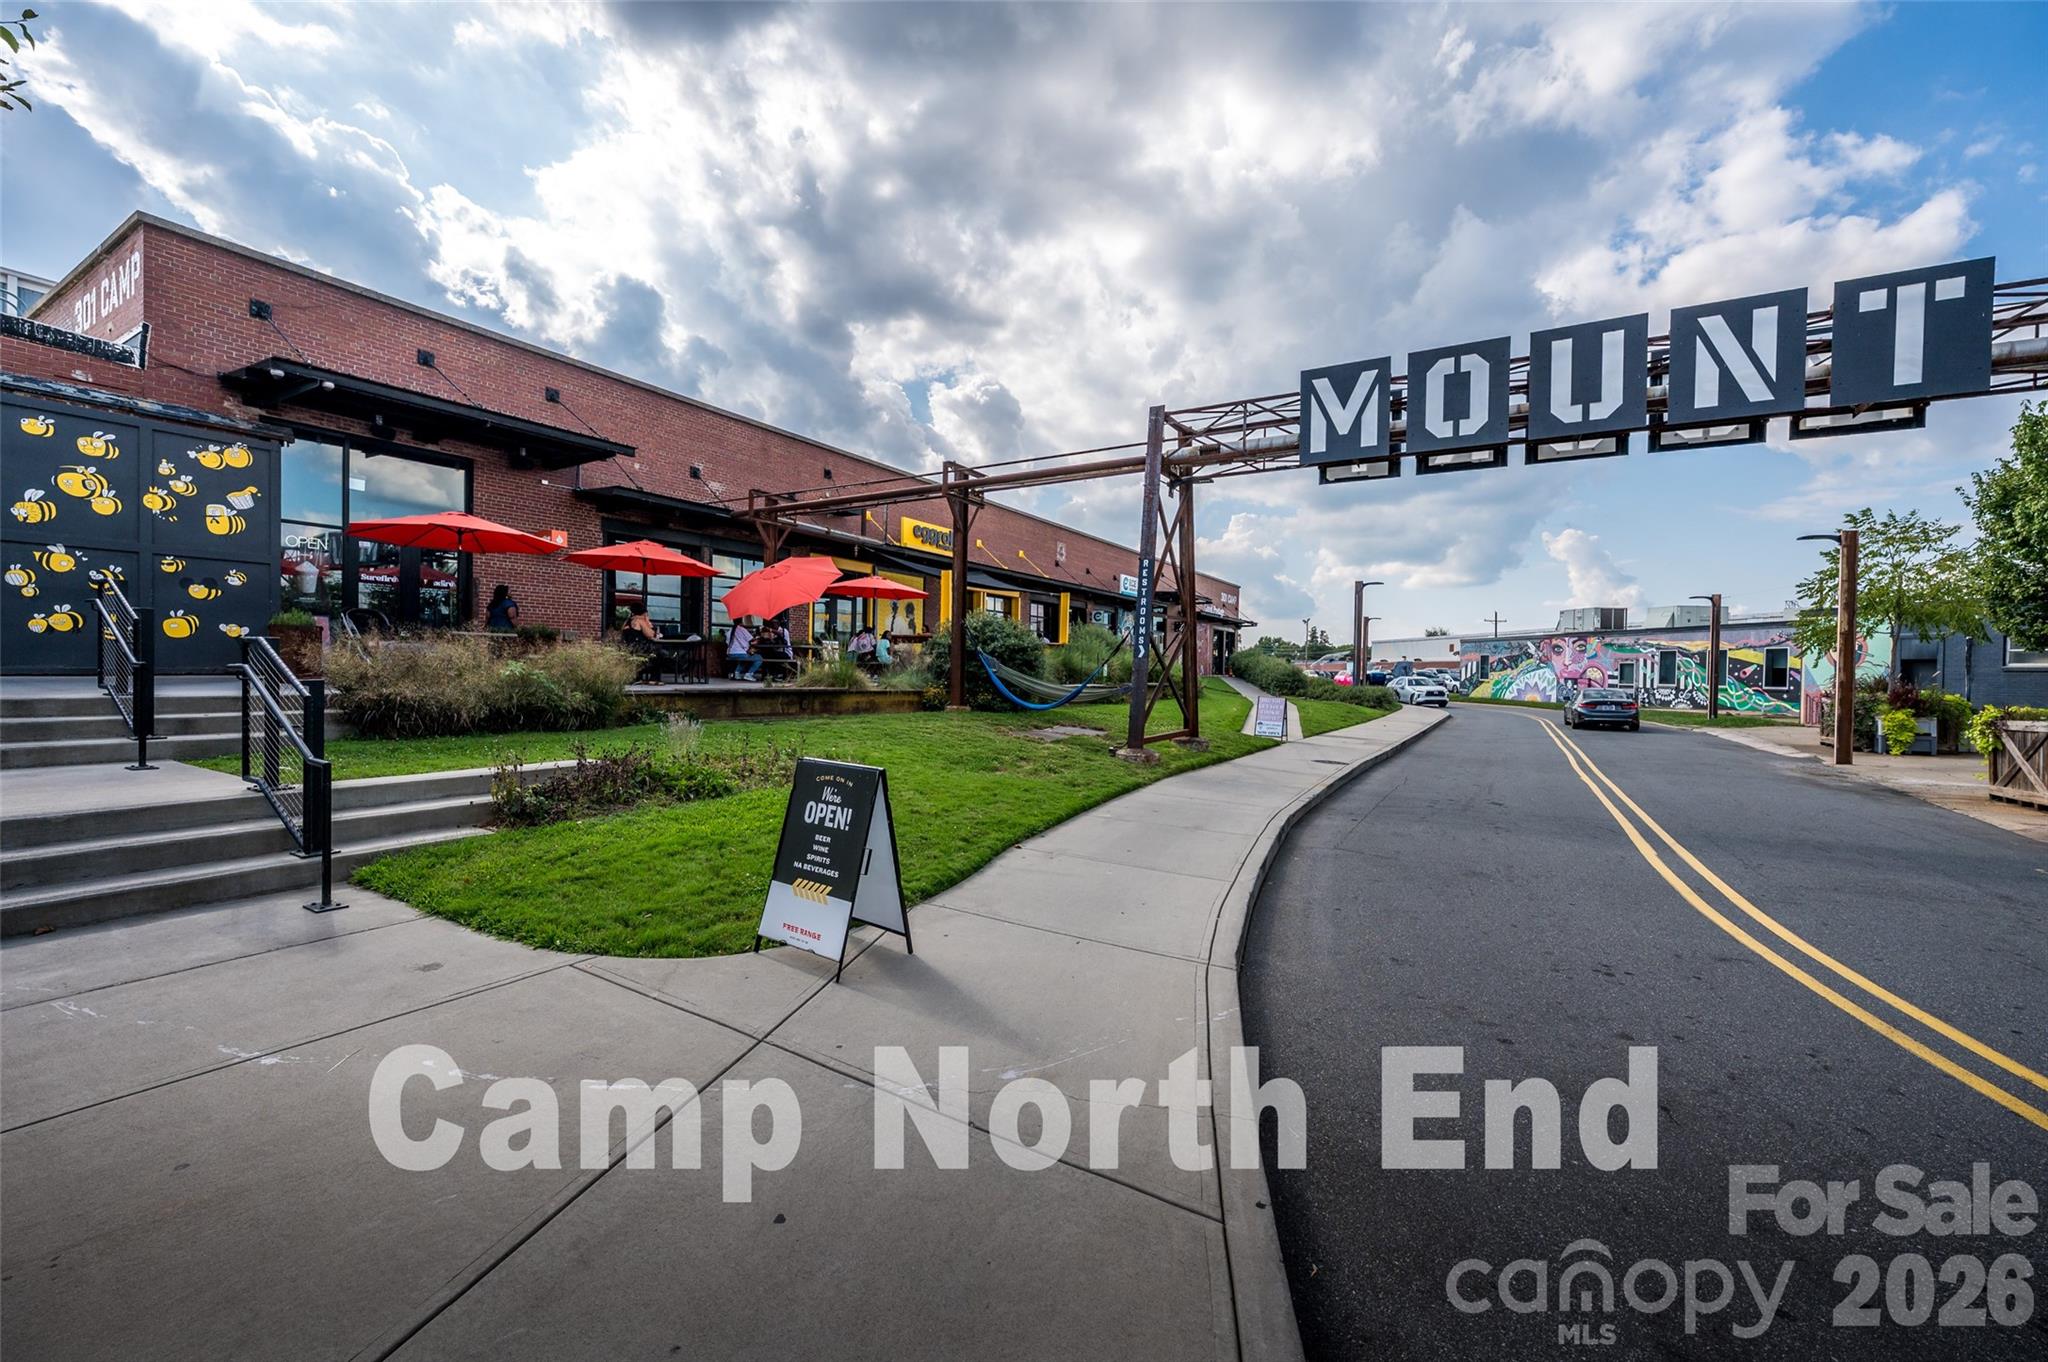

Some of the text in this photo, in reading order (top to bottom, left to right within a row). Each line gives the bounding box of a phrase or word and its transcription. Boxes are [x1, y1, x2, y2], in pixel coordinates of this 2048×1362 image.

[100, 251, 141, 318] CAMP
[1310, 276, 1966, 454] MOUNT
[285, 533, 329, 550] OPEN
[1138, 559, 1149, 645] RESTROOMS
[804, 800, 853, 831] OPEN!
[814, 834, 831, 843] BEER
[812, 844, 829, 853] WINE
[806, 853, 831, 865] SPIRITS
[793, 861, 839, 878] NA BEVERAGES
[782, 922, 799, 933] FREE
[800, 928, 822, 941] RANGE
